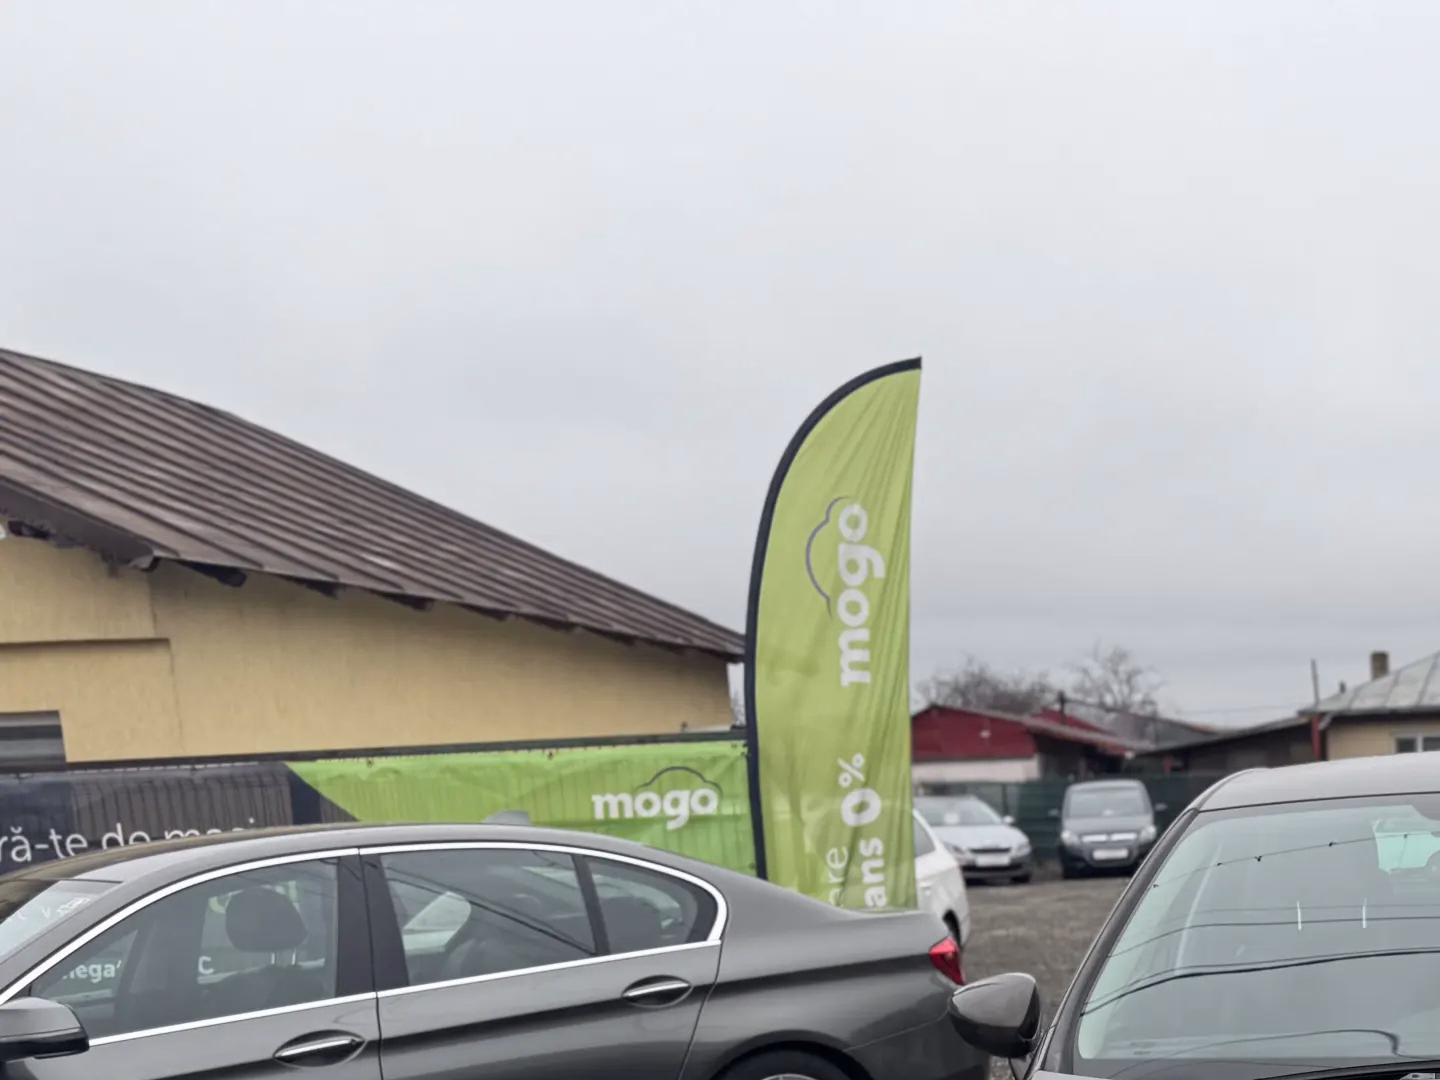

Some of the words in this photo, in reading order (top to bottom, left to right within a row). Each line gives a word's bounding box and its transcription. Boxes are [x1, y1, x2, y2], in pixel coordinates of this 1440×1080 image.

[837, 503, 885, 687] mogo
[591, 788, 718, 830] mogo
[838, 752, 882, 827] 0%
